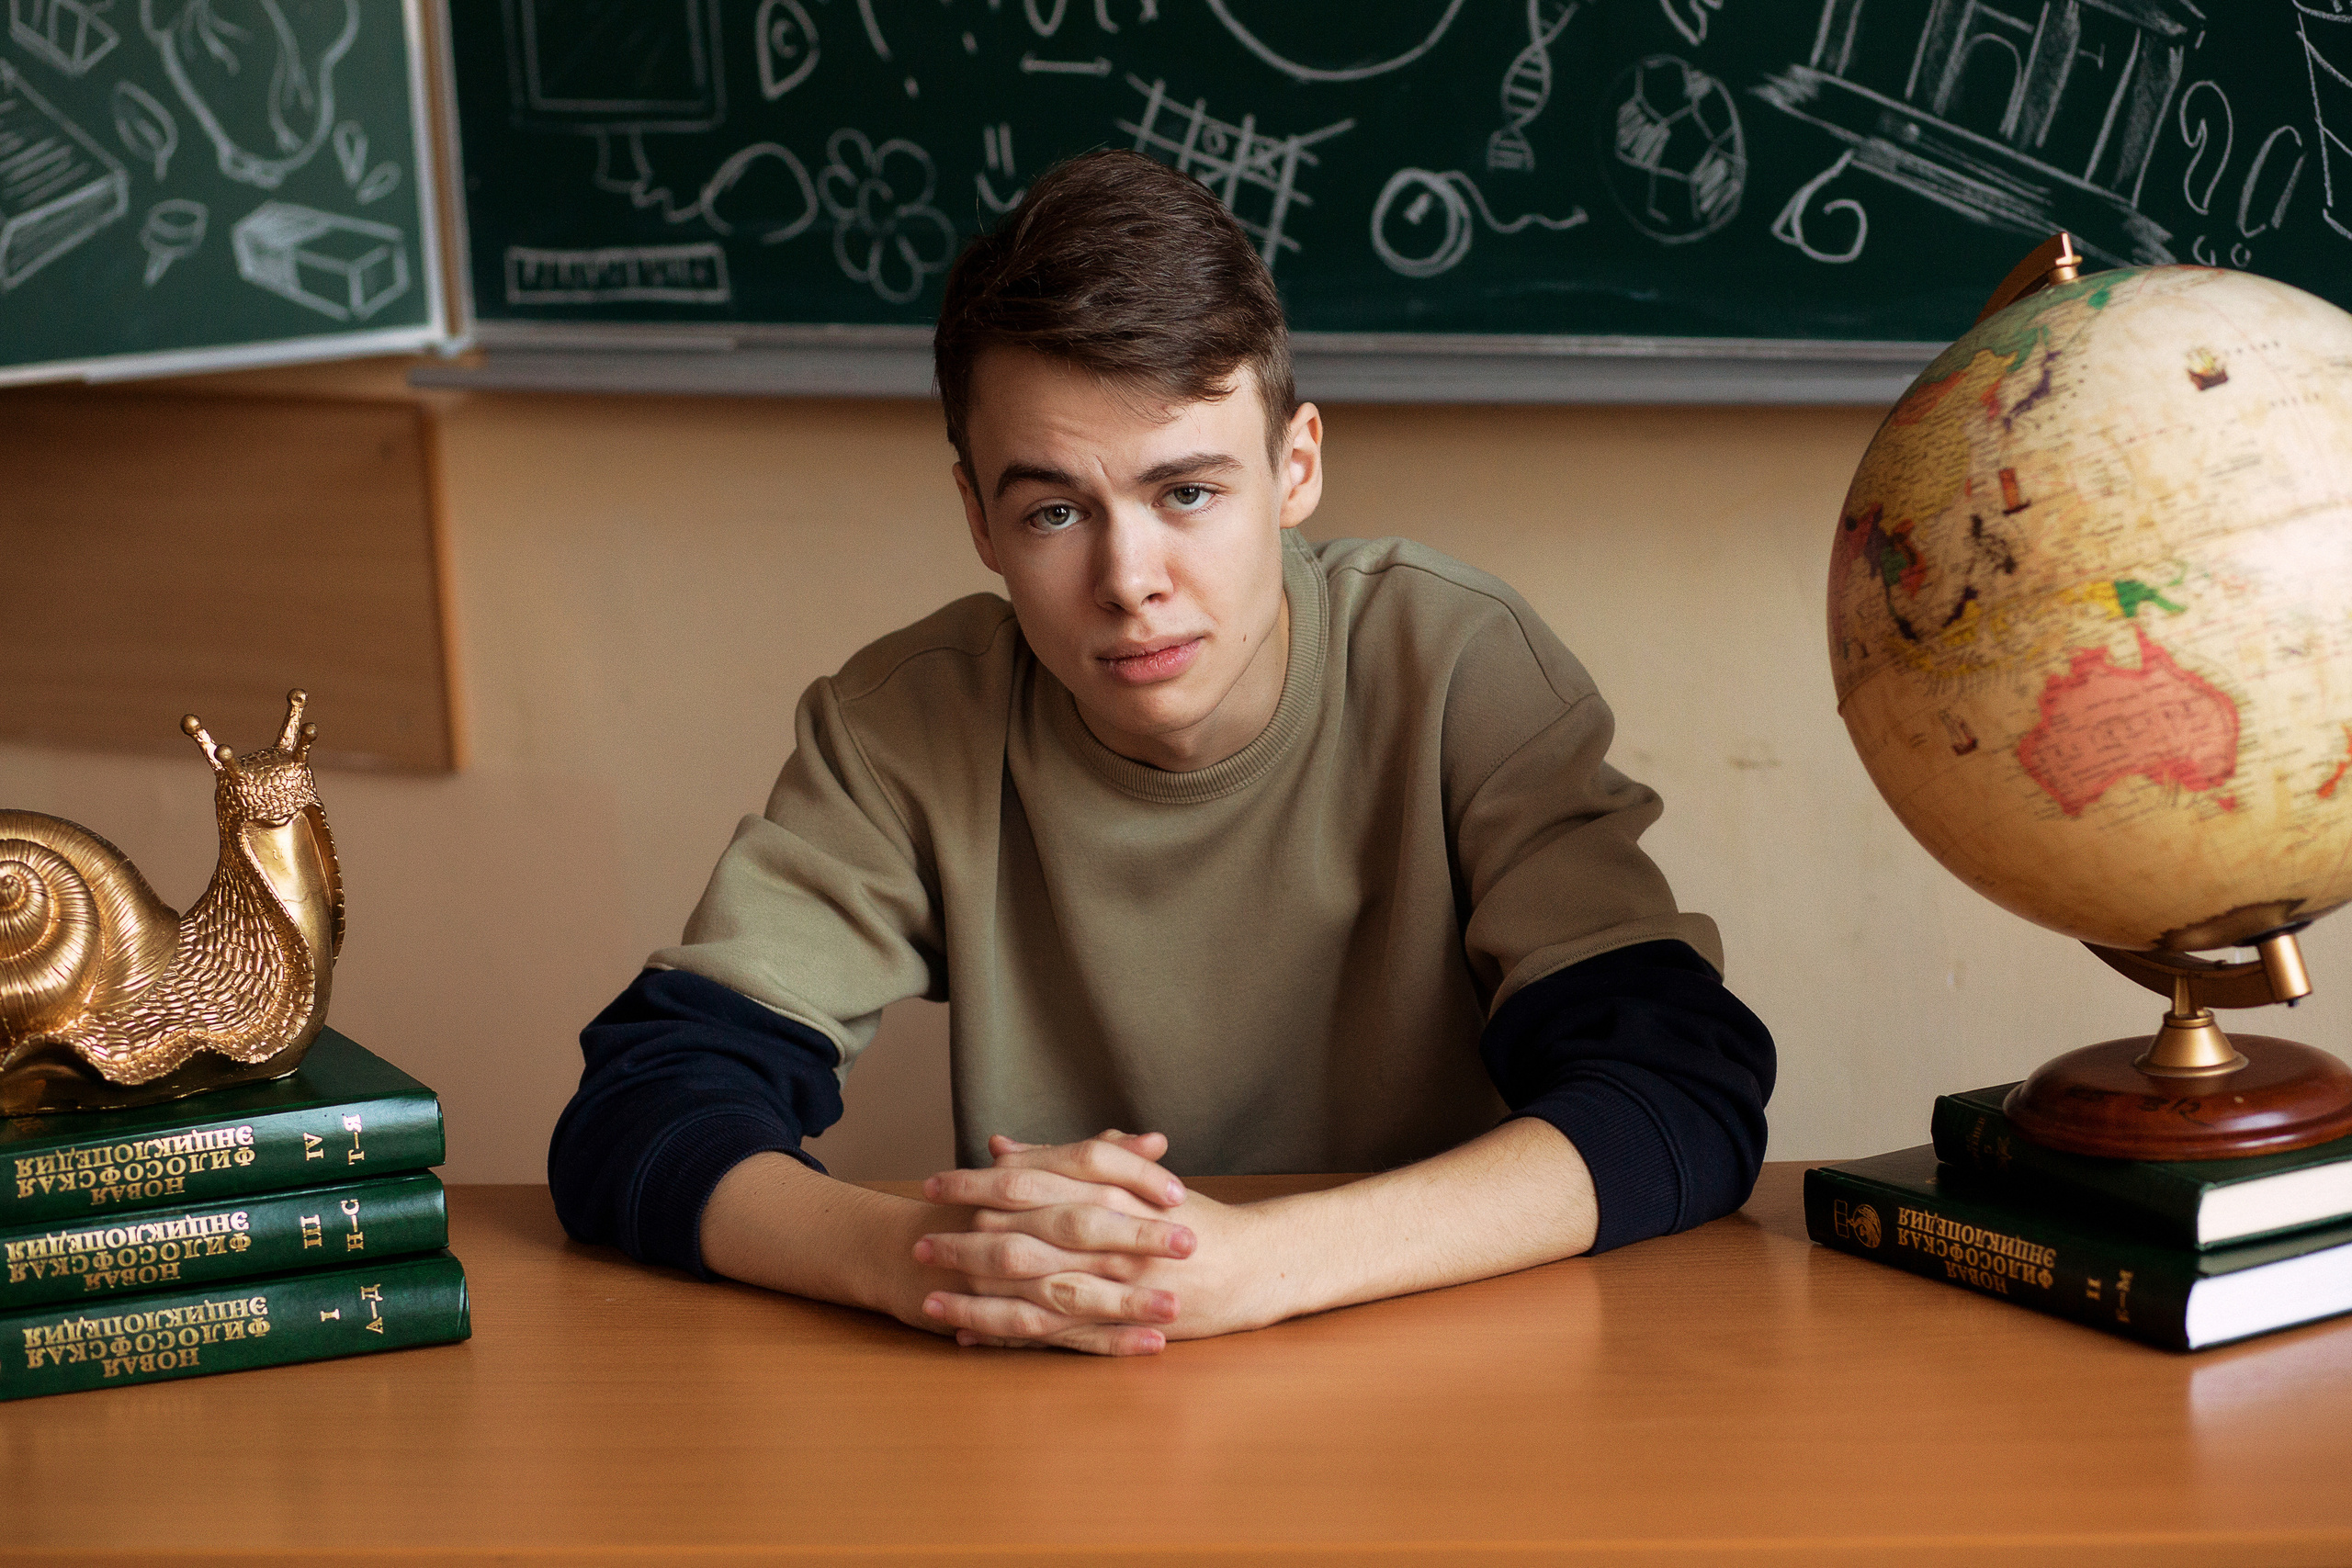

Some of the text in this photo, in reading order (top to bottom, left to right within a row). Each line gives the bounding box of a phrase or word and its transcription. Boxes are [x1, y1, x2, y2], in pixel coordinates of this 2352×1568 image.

[15, 1125, 254, 1179] ЭНЦИКЛОПЕДИЯ
[17, 1146, 255, 1198] ФИЛОСОФСКАЯ
[90, 1176, 186, 1205] НОВАЯ
[5, 1211, 250, 1263] ЭНЦИКЛОПЕДИЯ
[7, 1232, 252, 1283] ФИЛОСОФСКАЯ
[1897, 1206, 2057, 1269] ЭНЦИКЛОПЕДИЯ
[1897, 1227, 2053, 1290] ФИЛОСОФСКАЯ
[83, 1262, 181, 1292] НОВАЯ
[1944, 1260, 2008, 1294] НОВАЯ
[22, 1296, 268, 1348] ЭНЦИКЛОПЕДИЯ
[25, 1317, 270, 1369] ФИЛОСОФСКАЯ
[101, 1348, 199, 1378] НОВАЯ
